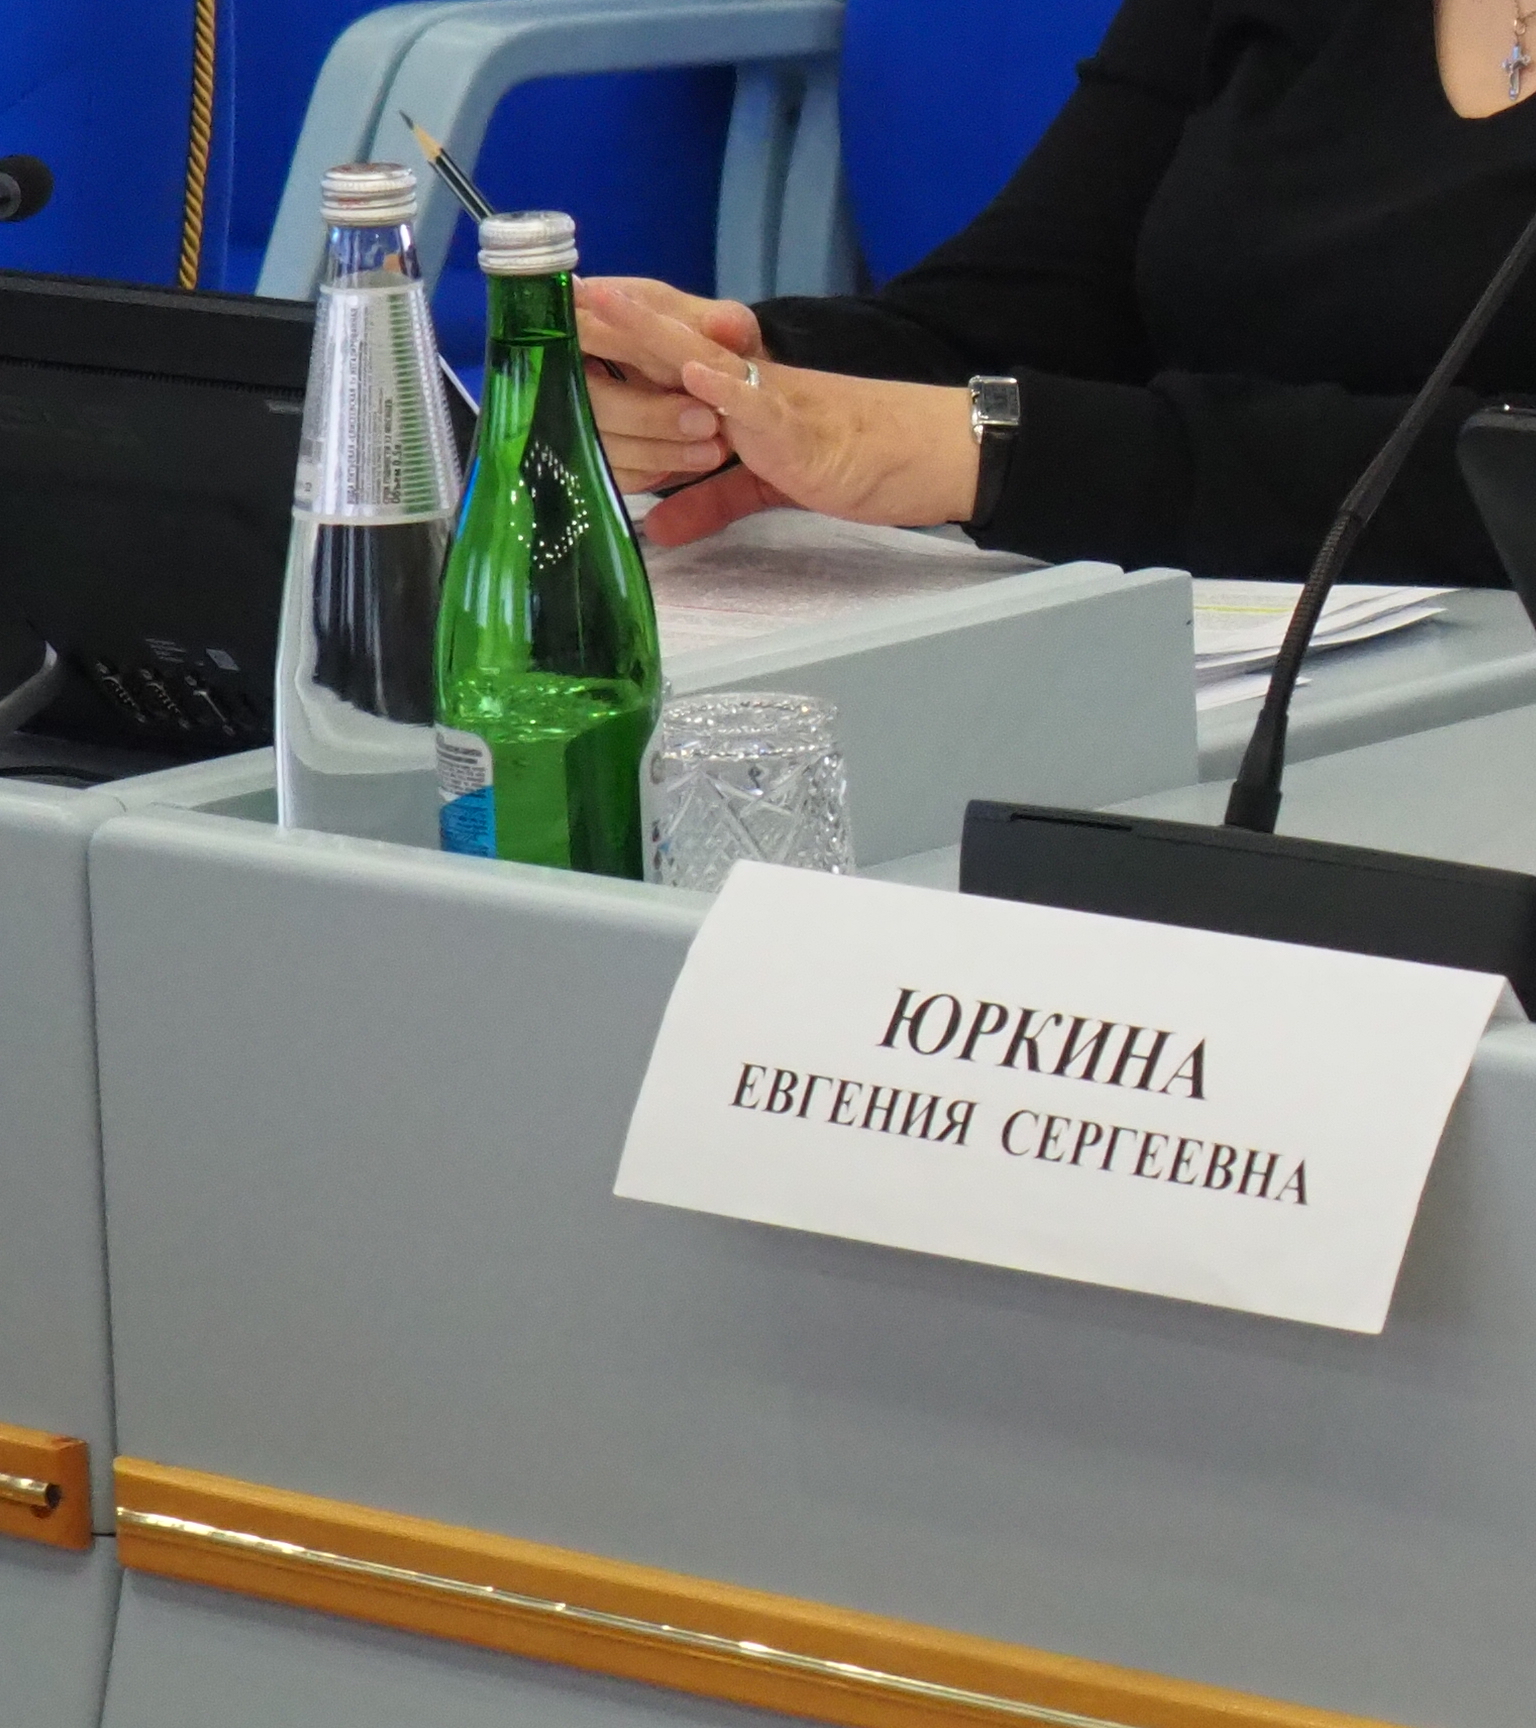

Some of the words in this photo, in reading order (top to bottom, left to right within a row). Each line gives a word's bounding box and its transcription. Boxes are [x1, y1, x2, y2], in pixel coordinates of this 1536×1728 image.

[877, 987, 1209, 1101] ЮРКИНА
[730, 1062, 979, 1147] ЕВГЕНИЯ
[1000, 1108, 1310, 1206] СЕРГЕЕВНА
